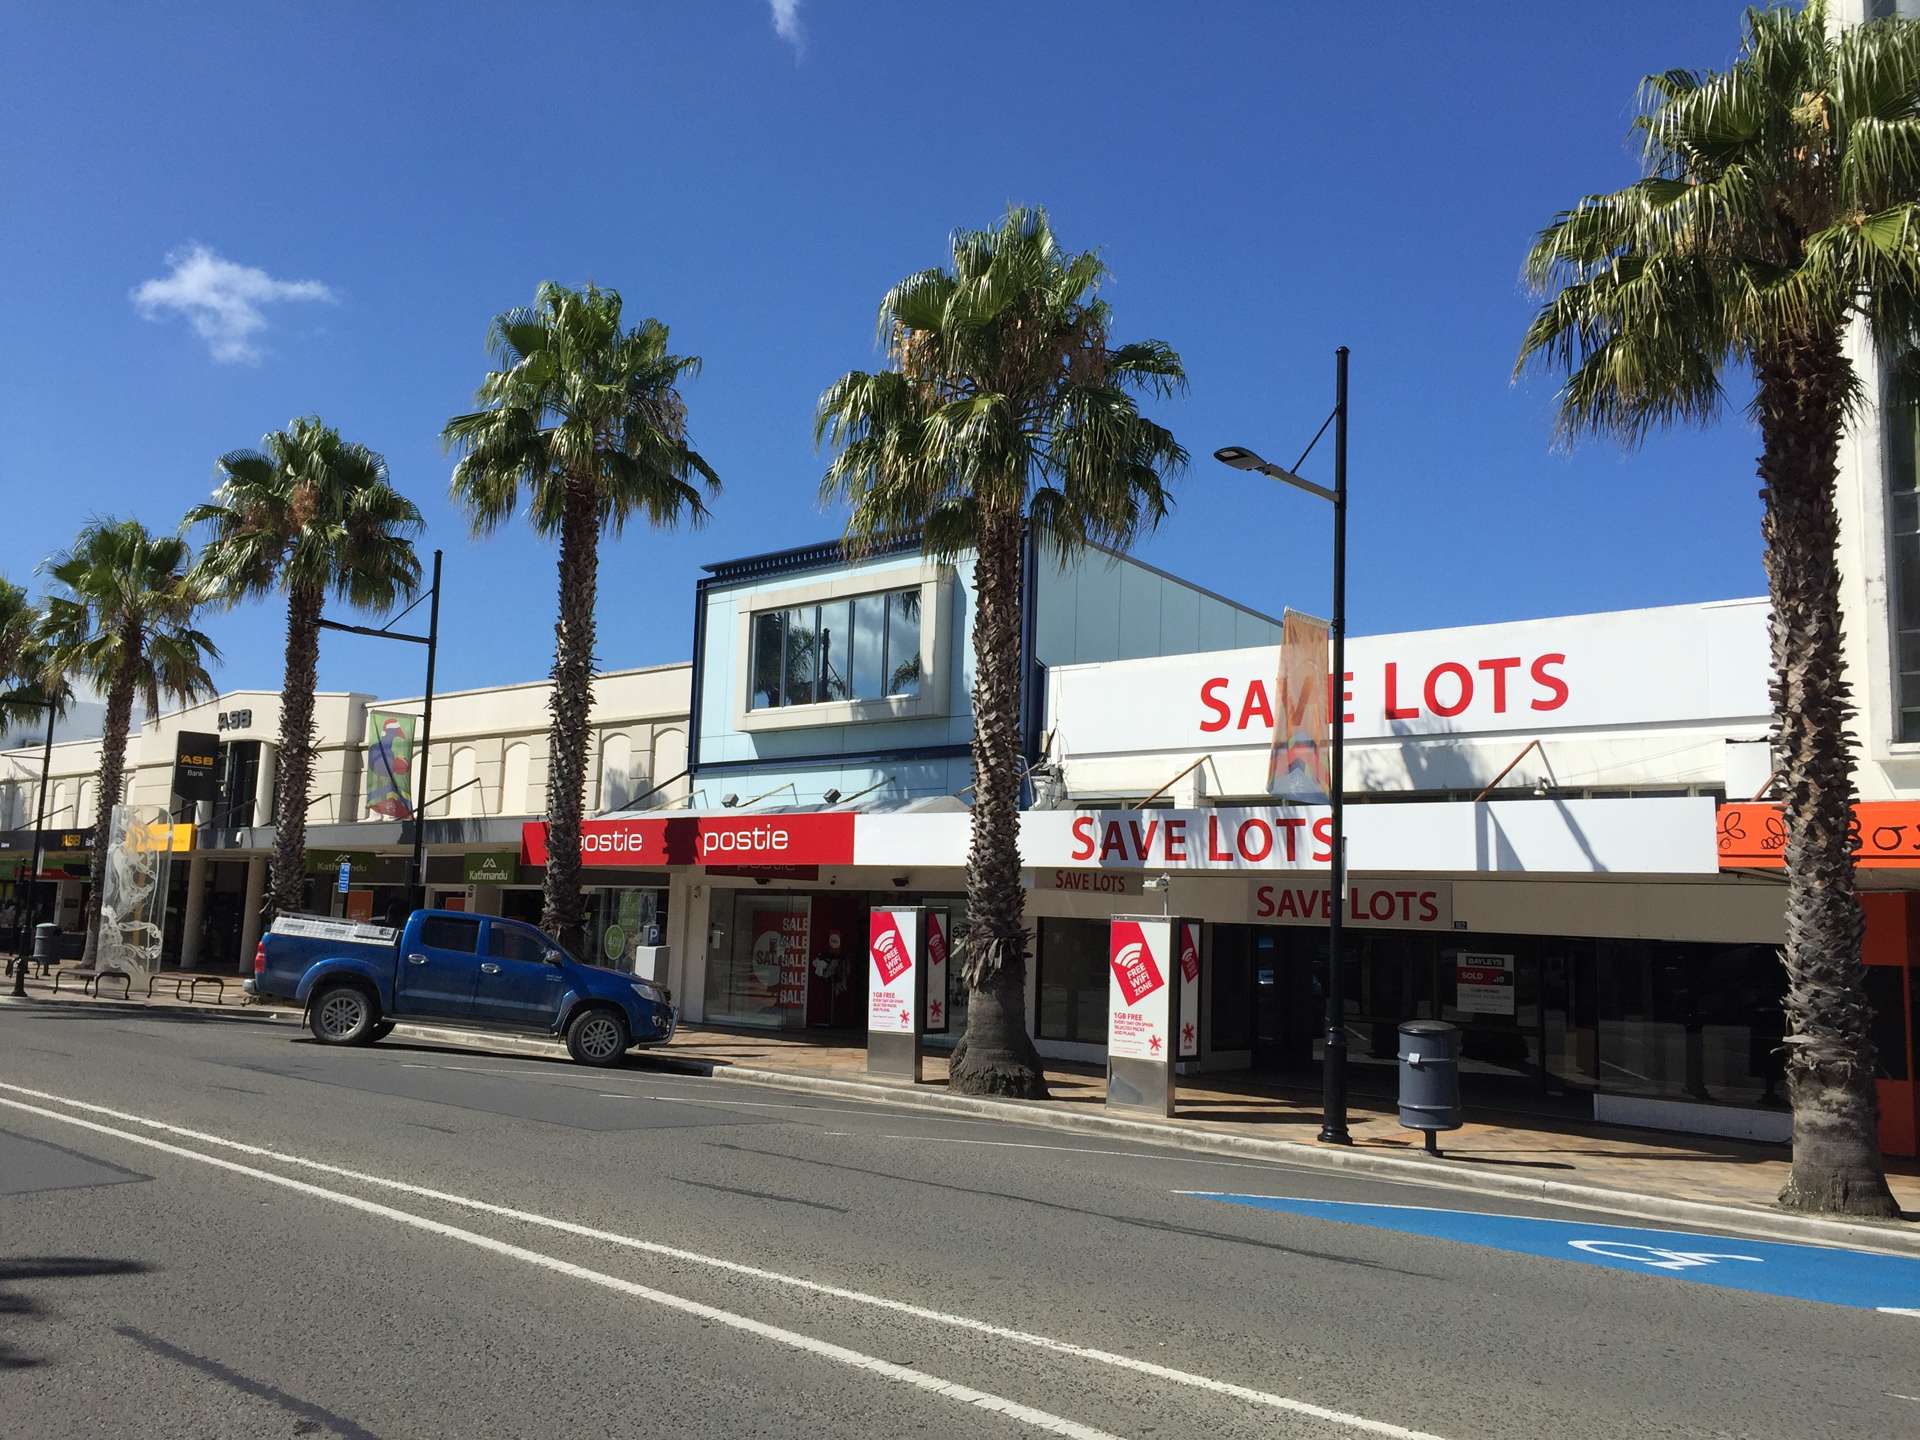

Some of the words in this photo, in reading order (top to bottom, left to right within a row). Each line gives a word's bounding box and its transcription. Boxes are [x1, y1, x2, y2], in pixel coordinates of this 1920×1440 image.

[1385, 653, 1569, 720] LOTS
[217, 709, 252, 731] ASB
[181, 755, 214, 766] ASB
[187, 769, 203, 777] Bank
[703, 823, 789, 857] postie
[1071, 816, 1186, 861] SAVE
[1208, 815, 1333, 862] LOTS
[317, 862, 368, 872] Kathndu
[469, 869, 508, 880] Kathmandu
[1055, 869, 1089, 890] SAVE
[1094, 873, 1126, 893] LOTS
[1256, 886, 1333, 919] SAVE
[1351, 888, 1439, 922] LOTS
[783, 918, 808, 931] SALE
[649, 928, 658, 939] P
[781, 954, 807, 968] SALE
[883, 947, 899, 961] FREE
[889, 964, 905, 977] ZONE
[1127, 962, 1146, 980] FREE
[1461, 972, 1484, 980] SOLD
[781, 972, 807, 985] SALE
[1134, 981, 1153, 997] ZONE
[780, 990, 806, 1004] SALE
[1114, 1012, 1127, 1020] 1GB
[1127, 1013, 1143, 1021] FREE
